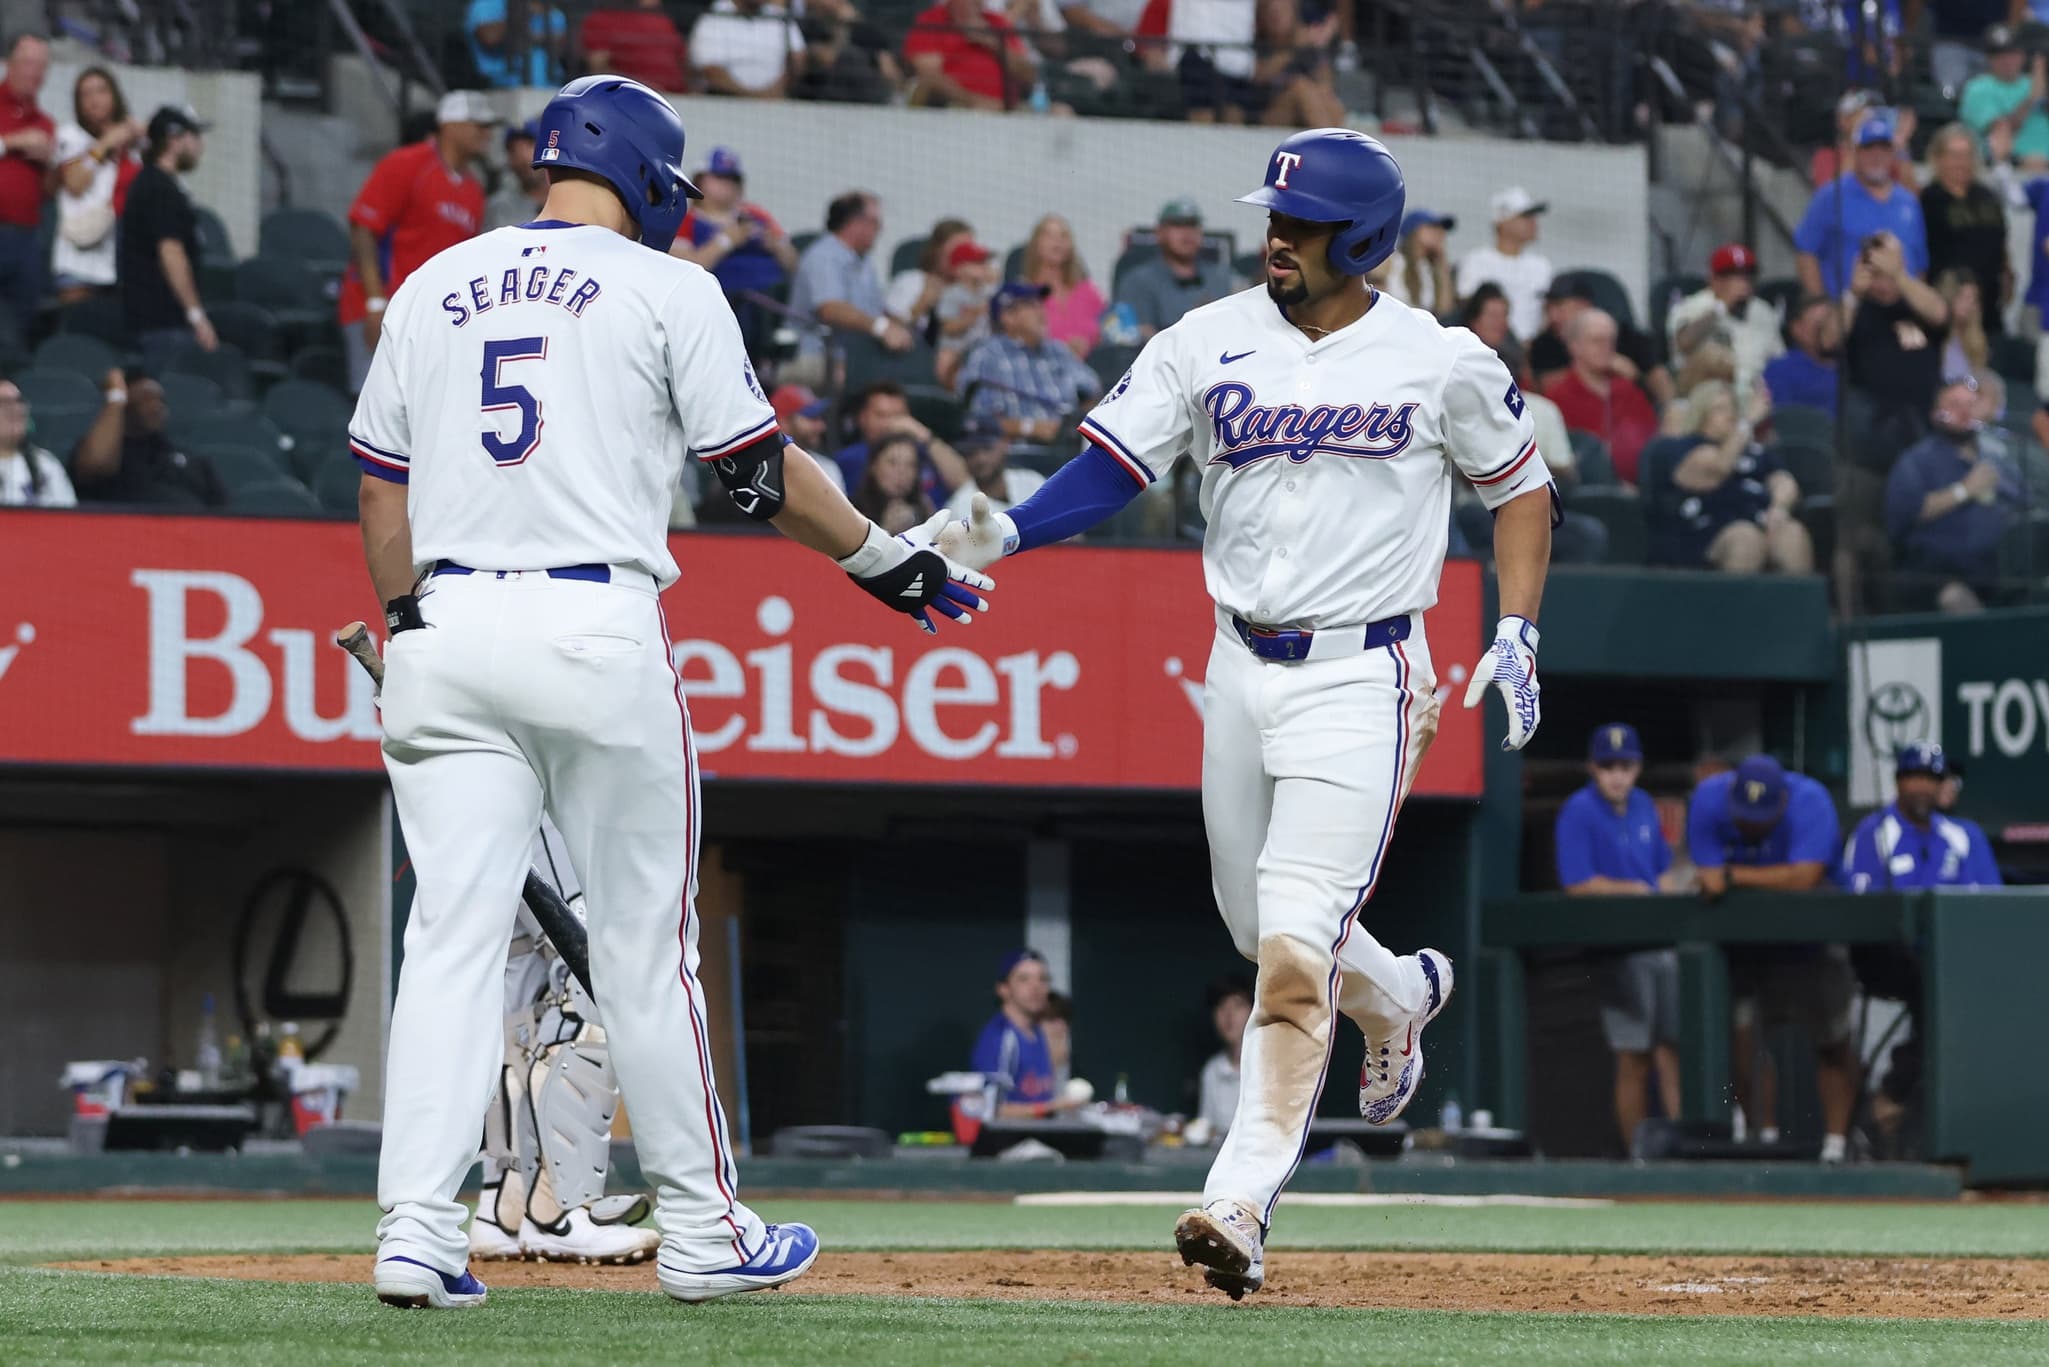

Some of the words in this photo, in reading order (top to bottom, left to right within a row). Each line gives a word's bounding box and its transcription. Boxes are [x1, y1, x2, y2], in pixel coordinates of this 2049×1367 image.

[548, 130, 560, 147] 5
[1275, 151, 1304, 190] T
[442, 266, 601, 327] SEAGER
[480, 336, 548, 467] 5
[1203, 381, 1420, 468] Rangers
[130, 568, 1080, 760] Bueiser
[1285, 641, 1296, 658] 2
